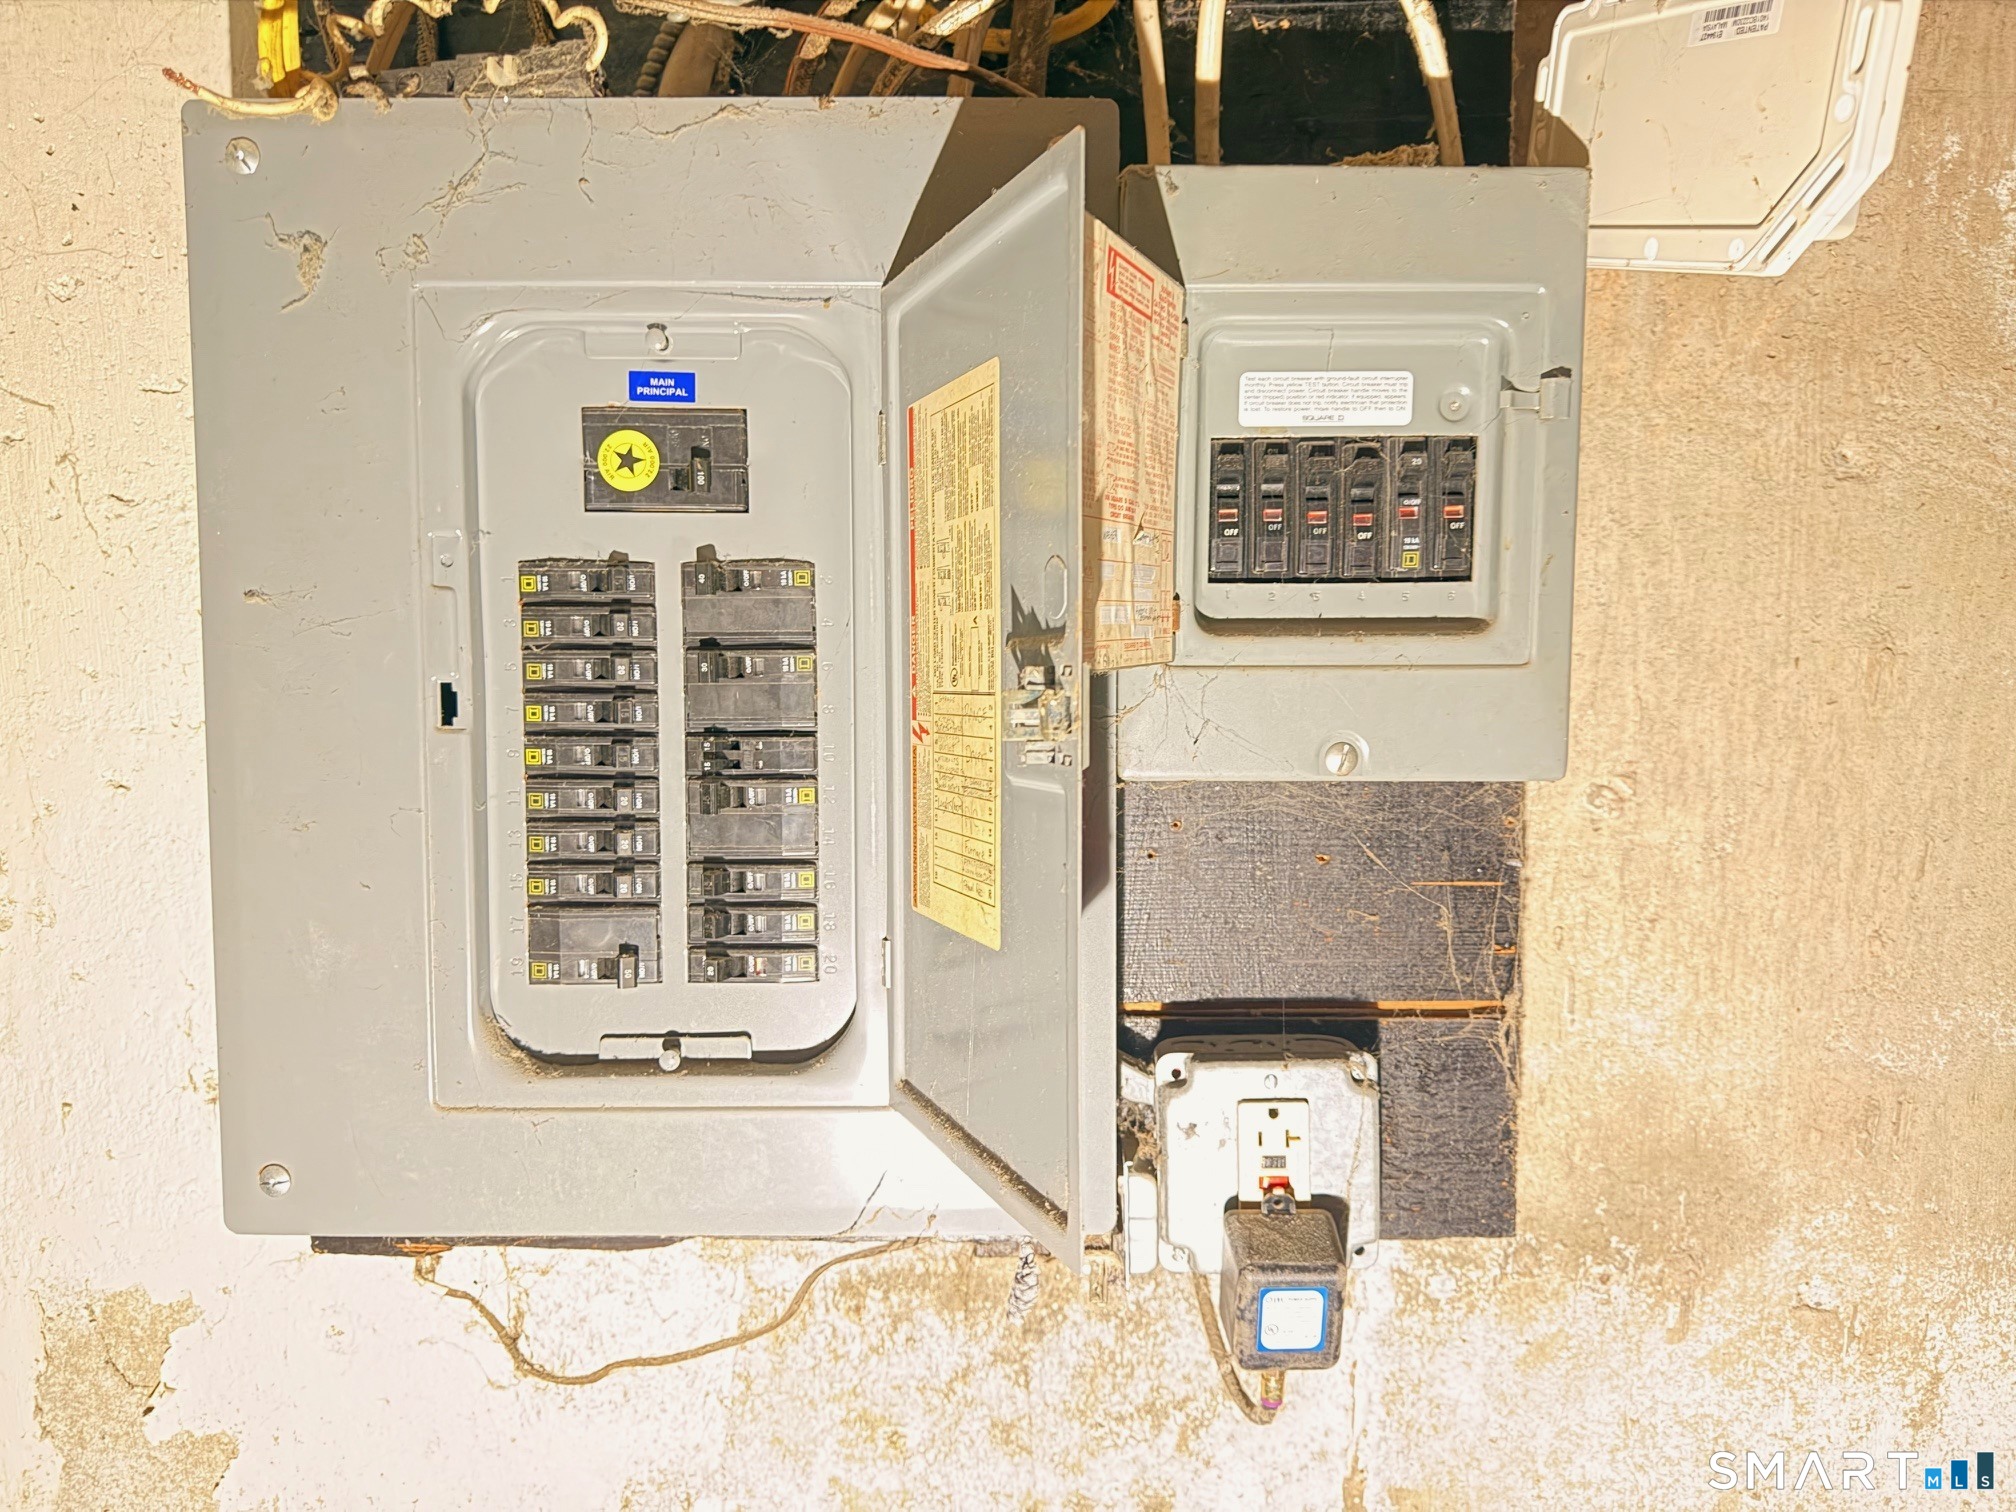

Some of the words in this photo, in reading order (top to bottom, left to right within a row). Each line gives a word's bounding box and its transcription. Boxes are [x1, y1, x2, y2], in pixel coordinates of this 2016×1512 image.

[1737, 23, 1769, 35] PATENTED
[650, 378, 675, 386] MAIN
[637, 387, 688, 396] PRINCIPAL
[642, 442, 653, 453] AIR
[603, 444, 612, 466] 22,000
[1411, 457, 1422, 465] 20
[645, 455, 655, 478] 22,000
[605, 469, 615, 480] AIR
[697, 471, 705, 485] 100
[1224, 528, 1239, 536] OFF
[698, 574, 705, 584] 40
[1268, 591, 1276, 601] 2
[1357, 590, 1365, 601] 4
[1402, 591, 1411, 601] 5
[1448, 590, 1456, 600] 6
[503, 619, 517, 628] 3
[617, 622, 624, 631] 20
[504, 663, 517, 671] 5
[617, 665, 625, 675] 20
[701, 662, 708, 672] 30
[822, 661, 833, 671] 6
[822, 705, 834, 714] 8
[704, 742, 710, 751] 15
[507, 749, 520, 758] 9
[704, 762, 711, 770] 15
[507, 787, 520, 805] 11
[823, 785, 835, 804] 12
[621, 797, 629, 806] 20
[507, 830, 522, 848] 13
[822, 828, 835, 846] 14
[621, 840, 628, 849] 20
[509, 873, 523, 891] 15
[823, 870, 836, 890] 16
[510, 916, 524, 933] 17
[823, 912, 836, 931] 18
[509, 958, 524, 977] 19
[824, 955, 837, 974] 20
[624, 969, 632, 979] 50
